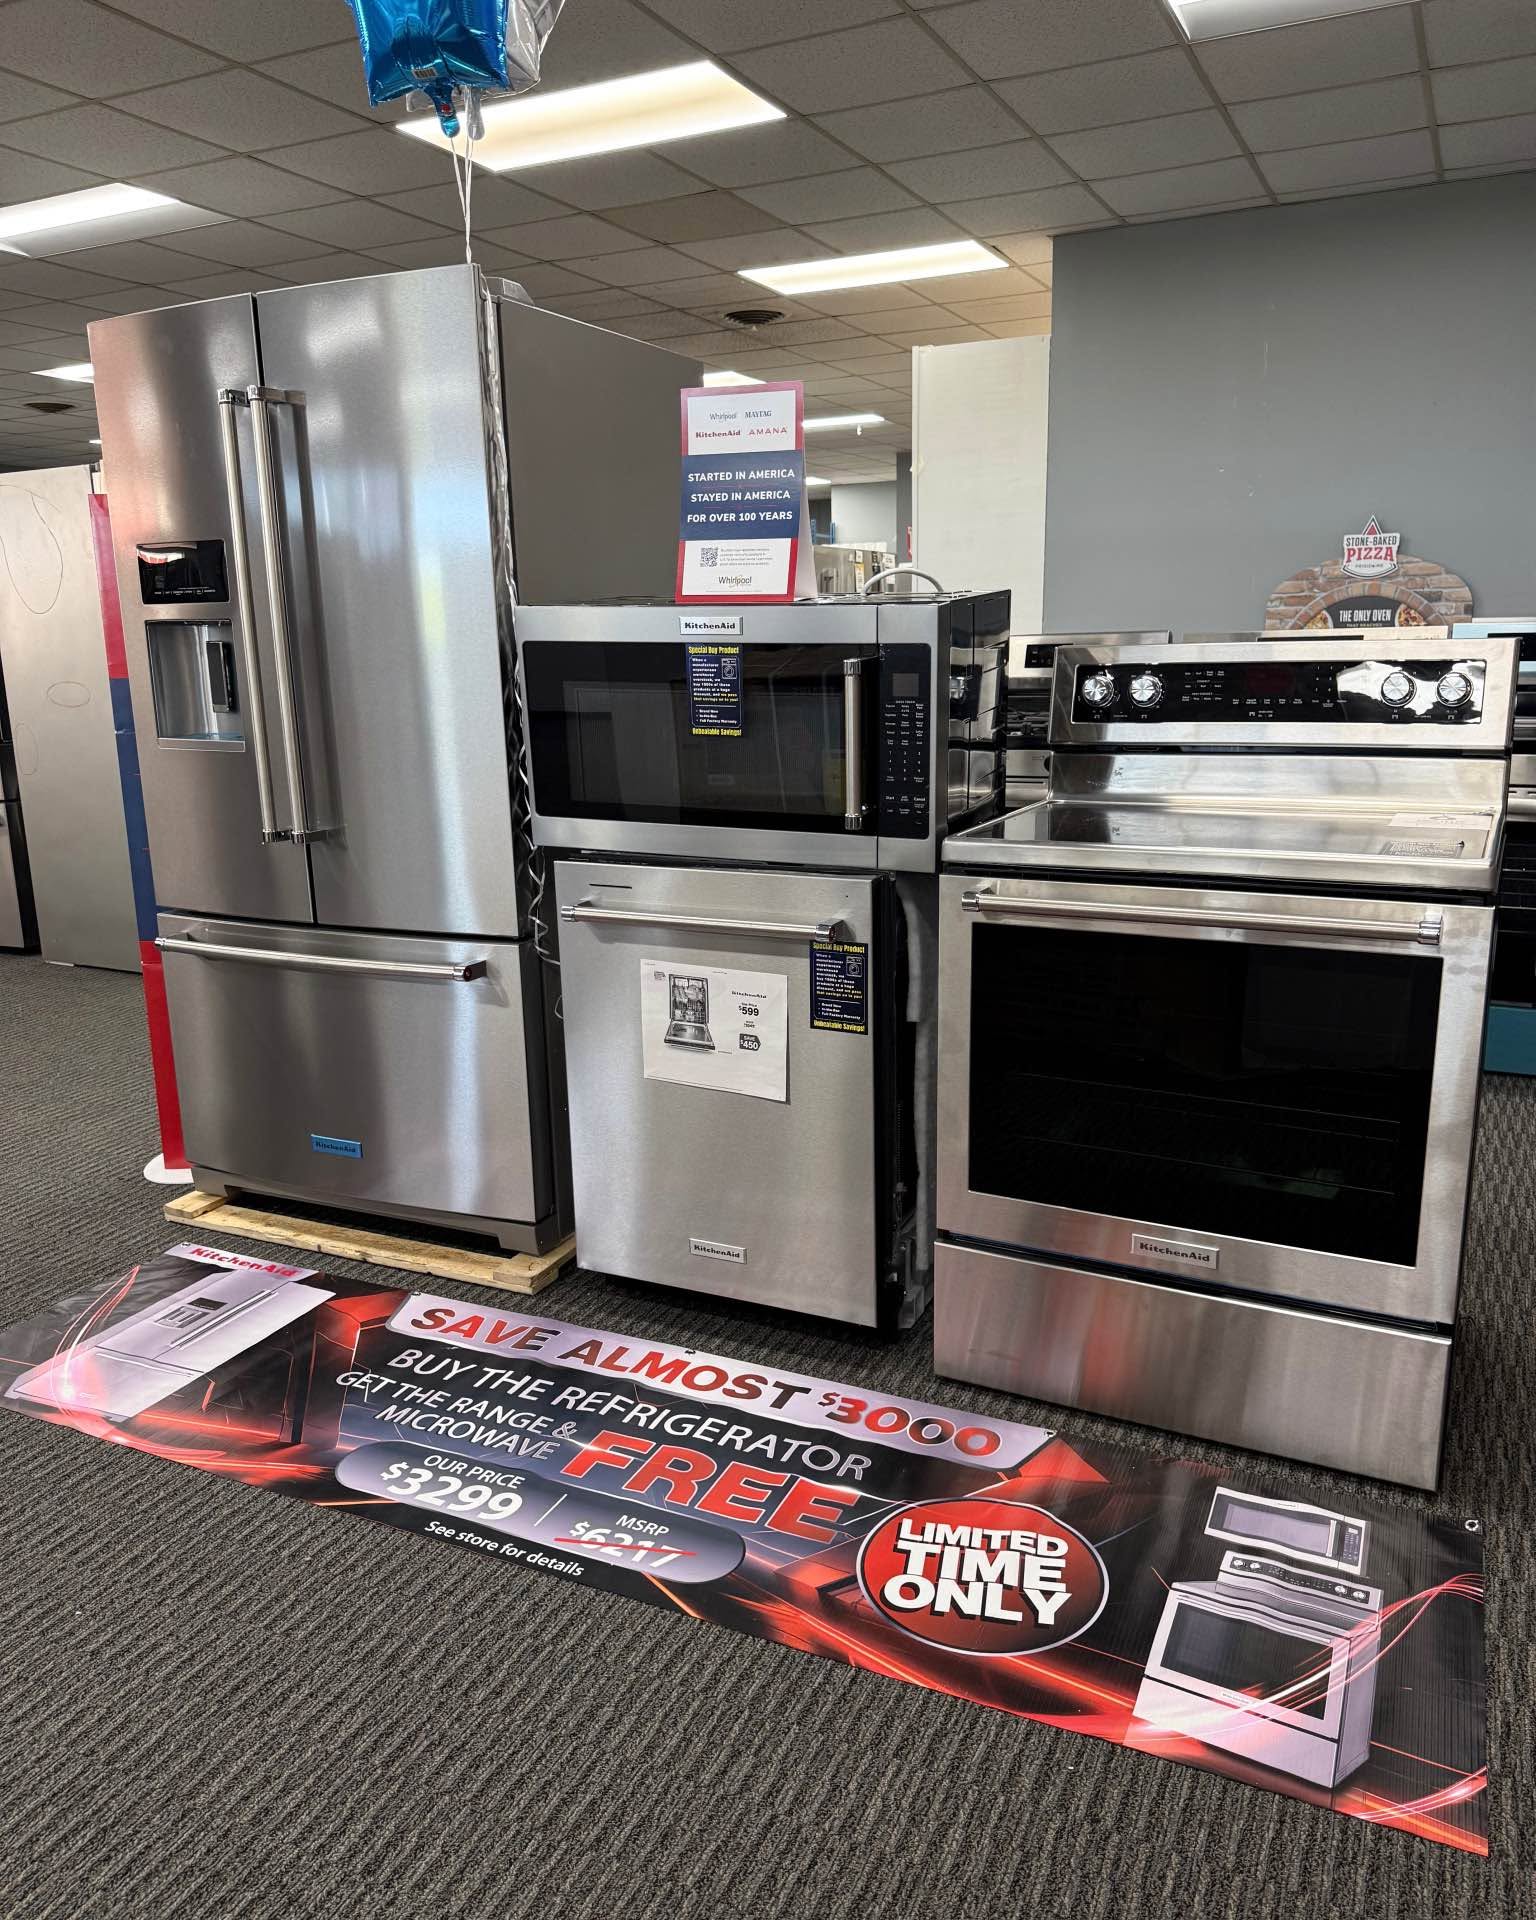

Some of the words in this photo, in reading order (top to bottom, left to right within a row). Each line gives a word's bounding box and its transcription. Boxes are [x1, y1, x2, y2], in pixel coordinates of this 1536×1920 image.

[710, 412, 736, 421] Whirlpool
[696, 430, 740, 438] KitchenAid
[749, 427, 787, 435] AMANA
[688, 472, 732, 482] STARTED
[736, 471, 746, 480] IN
[749, 469, 795, 479] AMERICA
[691, 493, 728, 502] STAYED
[732, 492, 741, 501] IN
[744, 491, 790, 500] AMERICA
[687, 514, 706, 522] FOR
[709, 513, 736, 522] OVER
[739, 513, 756, 521] 100
[759, 511, 792, 520] YEARS
[1345, 535, 1397, 547] STONE-BAKED
[1346, 546, 1394, 564] PIZZA
[718, 576, 752, 586] Whirlpool
[1340, 610, 1352, 622] THE
[1354, 610, 1370, 622] ONLY
[1372, 609, 1392, 621] OVEN
[688, 646, 707, 654] Special
[708, 646, 718, 655] Buy
[719, 646, 739, 654] Product
[813, 942, 832, 950] Special
[844, 945, 864, 953] Product
[739, 1006, 759, 1016] $599
[814, 1020, 842, 1029] Unbeatable
[843, 1024, 864, 1032] Savings!
[740, 1040, 759, 1050] $450
[694, 1244, 740, 1258] KitchenAid
[1140, 1242, 1210, 1262] KitchenAid
[190, 1248, 298, 1277] KitchenAid
[410, 1308, 562, 1351] SAVE
[556, 1339, 812, 1410] ALMOST
[817, 1392, 1002, 1457] $3000
[336, 1371, 397, 1393] GET
[392, 1383, 451, 1408] THE
[446, 1397, 554, 1435] RANGE
[551, 1420, 577, 1439] &
[386, 1349, 477, 1380] BUY
[473, 1367, 555, 1400] THE
[551, 1386, 872, 1481] REFRIGERATOR
[375, 1404, 561, 1460] MICROWAVE
[423, 1454, 471, 1474] OUR
[466, 1464, 526, 1489] PRICE
[380, 1462, 523, 1520] $3299
[560, 1429, 863, 1545] FREE
[616, 1514, 670, 1536] MSRP
[569, 1521, 687, 1568] $6217
[898, 1518, 1070, 1560] LIMITED
[424, 1521, 456, 1538] See
[456, 1529, 499, 1552] store
[499, 1542, 526, 1559] for
[526, 1549, 585, 1577] details
[904, 1547, 1068, 1592] TIME
[882, 1576, 1072, 1626] ONLY
